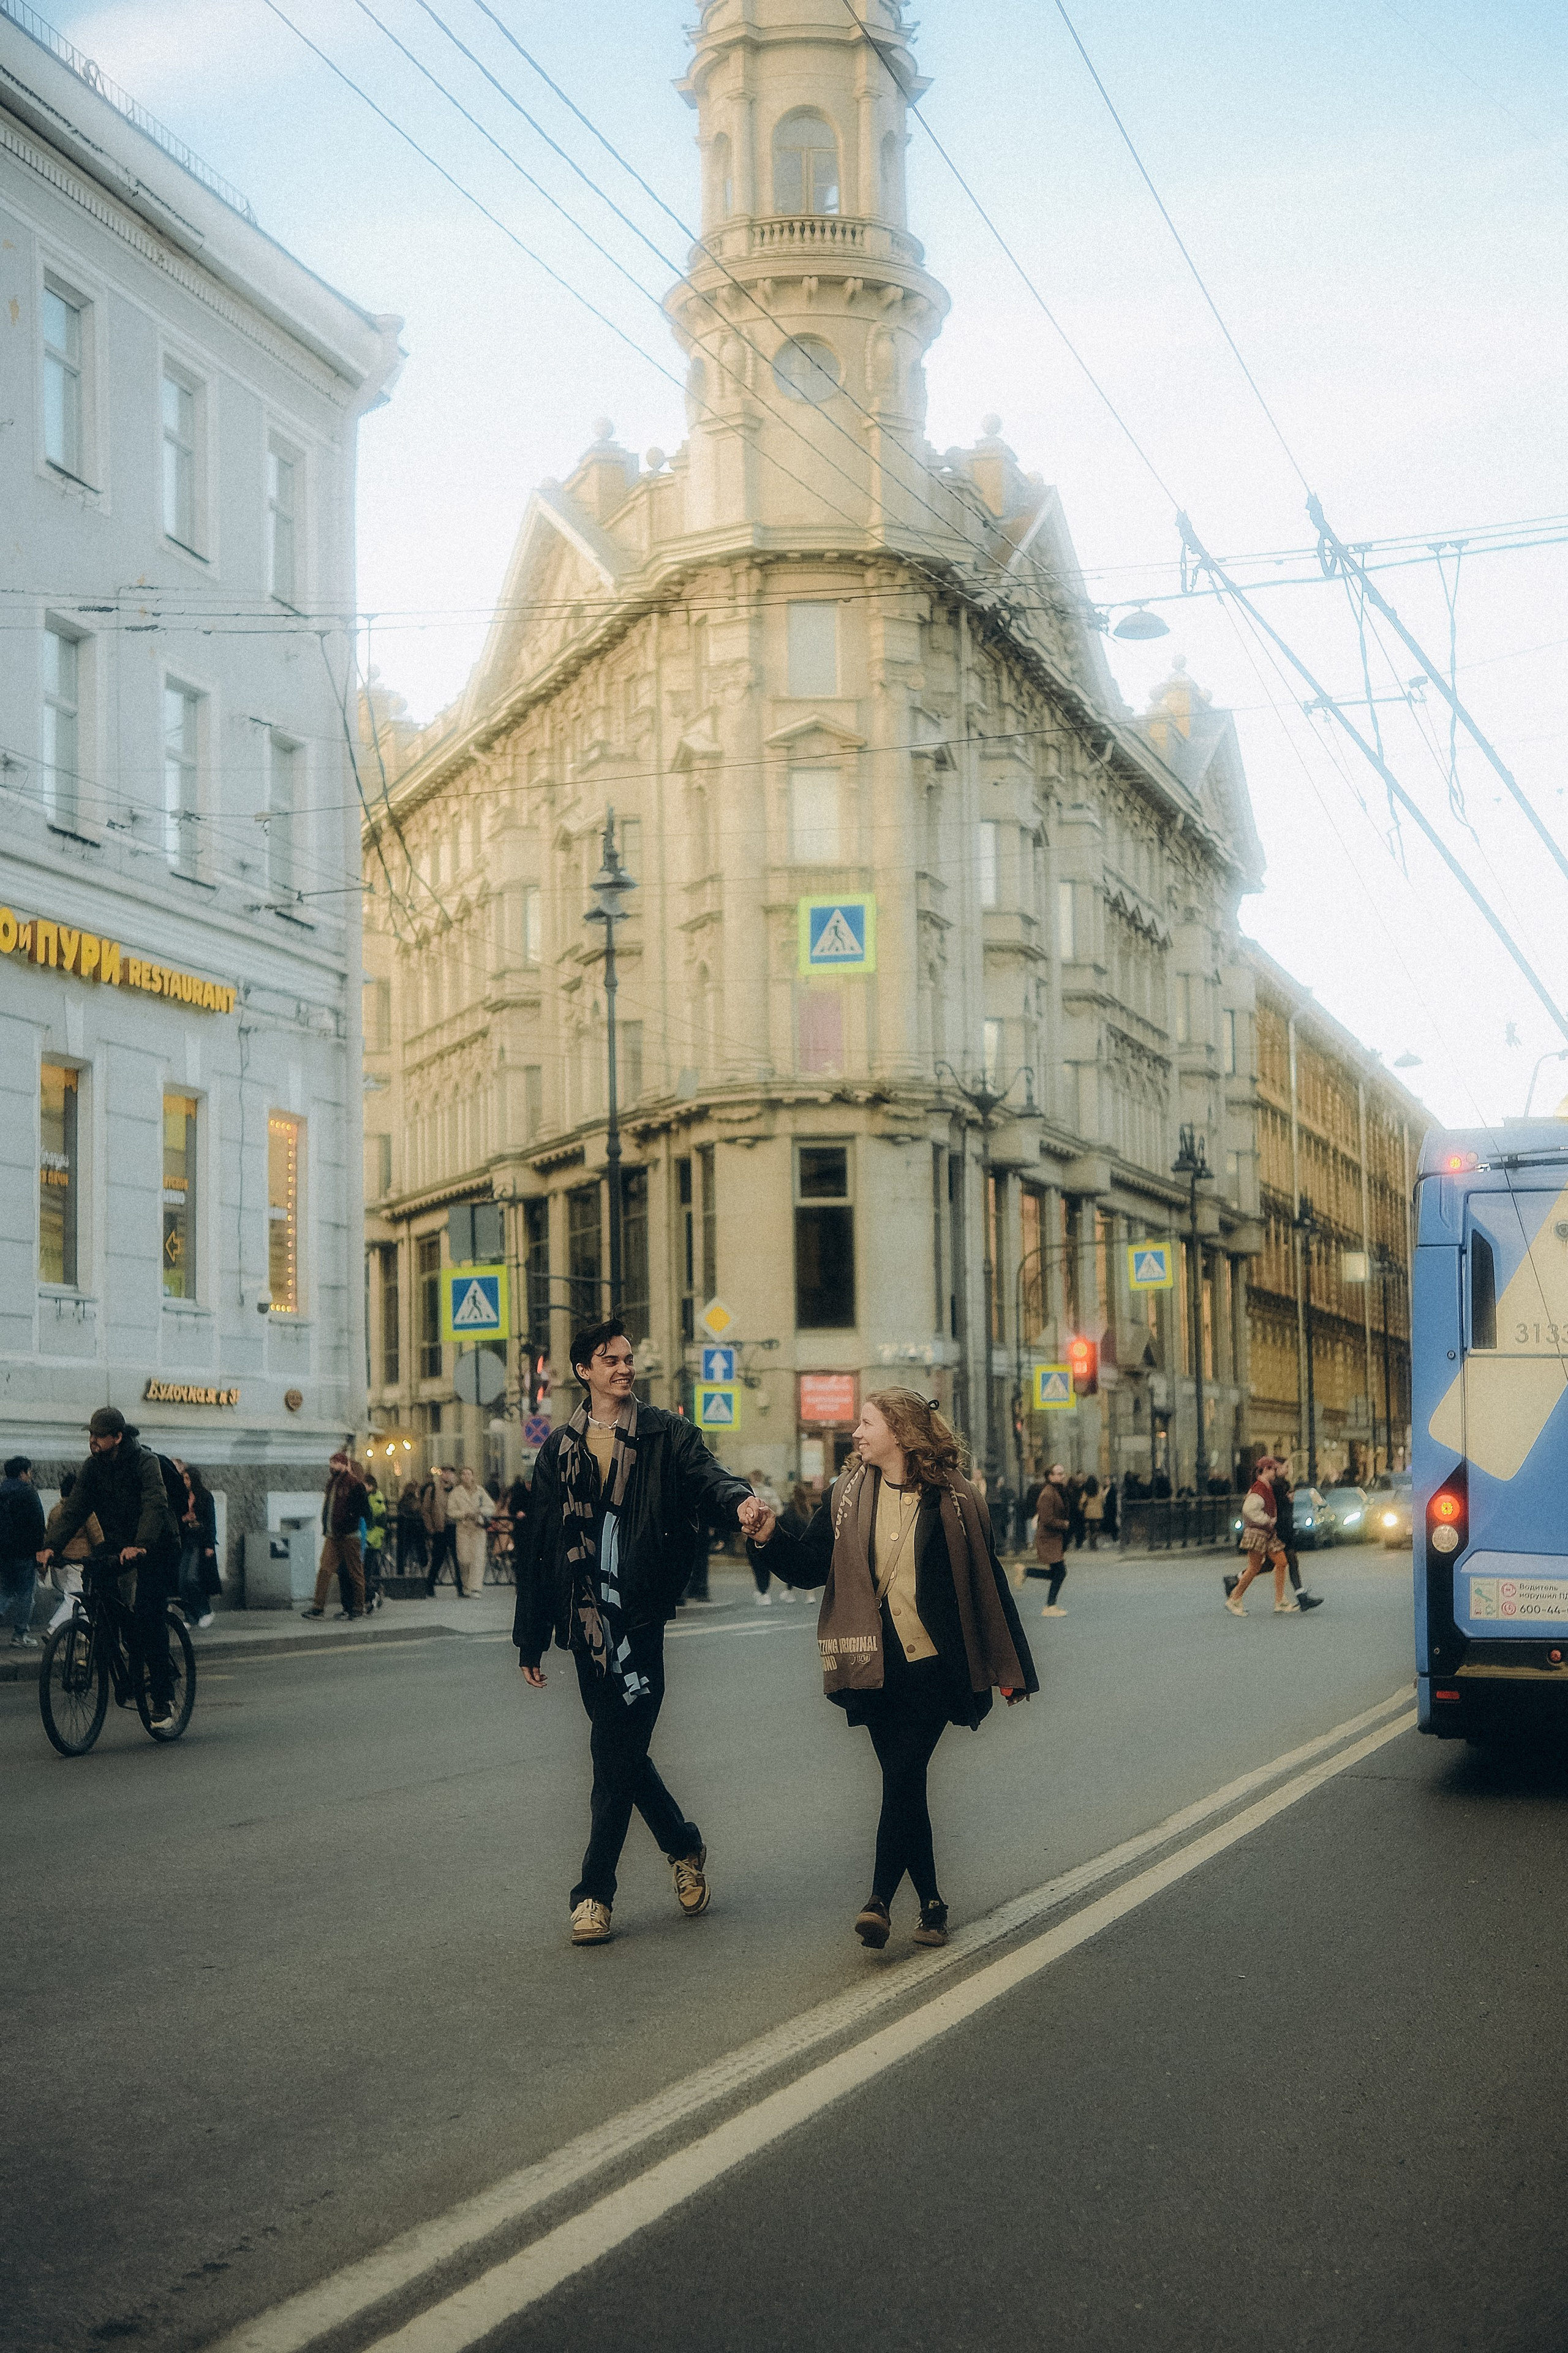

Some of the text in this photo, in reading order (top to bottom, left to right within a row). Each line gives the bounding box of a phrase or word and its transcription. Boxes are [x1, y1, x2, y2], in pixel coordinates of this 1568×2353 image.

[36, 919, 121, 986] ПУРИ
[129, 957, 236, 1013] RESTAURANT
[1519, 1582, 1558, 1591] Водитель
[1520, 1604, 1568, 1614] 600-44-
